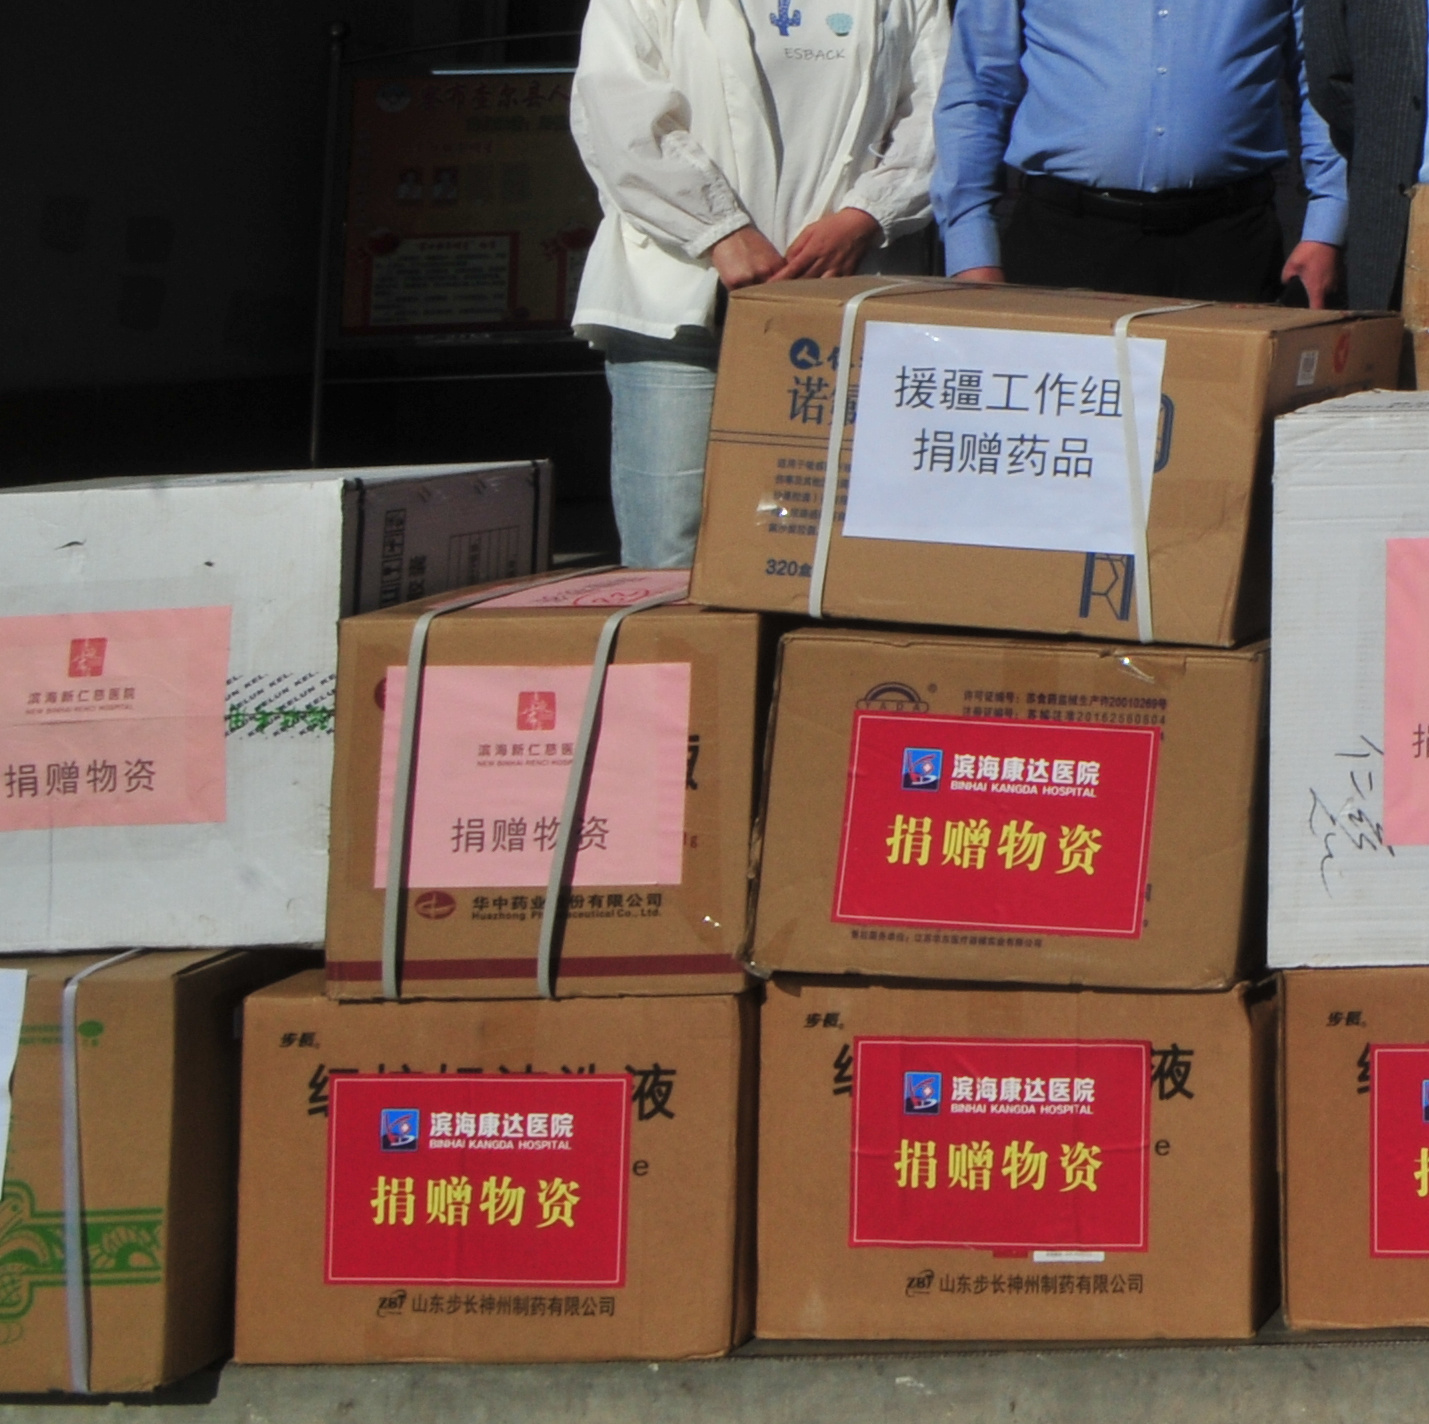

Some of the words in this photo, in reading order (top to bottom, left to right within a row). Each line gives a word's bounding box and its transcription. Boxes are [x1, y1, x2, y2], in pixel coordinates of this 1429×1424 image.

[894, 364, 1122, 417] 援疆工作组
[913, 427, 1094, 478] 捐赠药品
[478, 743, 574, 757] 滨海新仁慈医
[4, 758, 156, 799] 捐赠物资
[951, 753, 1100, 787] 滨海康达医院
[951, 780, 987, 793] BINHAI
[992, 782, 1038, 796] KANGDA
[1041, 785, 1097, 799] HOSPITAL
[451, 815, 610, 854] 捐赠物资
[886, 814, 1102, 876] 捐赠物资
[472, 893, 663, 911] 华中药业份有限公司
[951, 1075, 1096, 1103] 滨海康达医院
[951, 1103, 986, 1114] BINHAI
[991, 1104, 1036, 1115] KANGDA
[1040, 1104, 1094, 1115] HOSPITAL
[430, 1112, 574, 1139] 滨海康达医院
[429, 1139, 465, 1150] BINHAI
[469, 1139, 514, 1150] KANGDA
[518, 1139, 572, 1150] HOSPITAL
[895, 1139, 1103, 1193] 捐赠物资
[371, 1176, 580, 1229] 捐赠物资
[939, 1274, 1144, 1296] 山东步长神州制药有限公司
[412, 1294, 616, 1318] 山东步长神州制药有限公司
